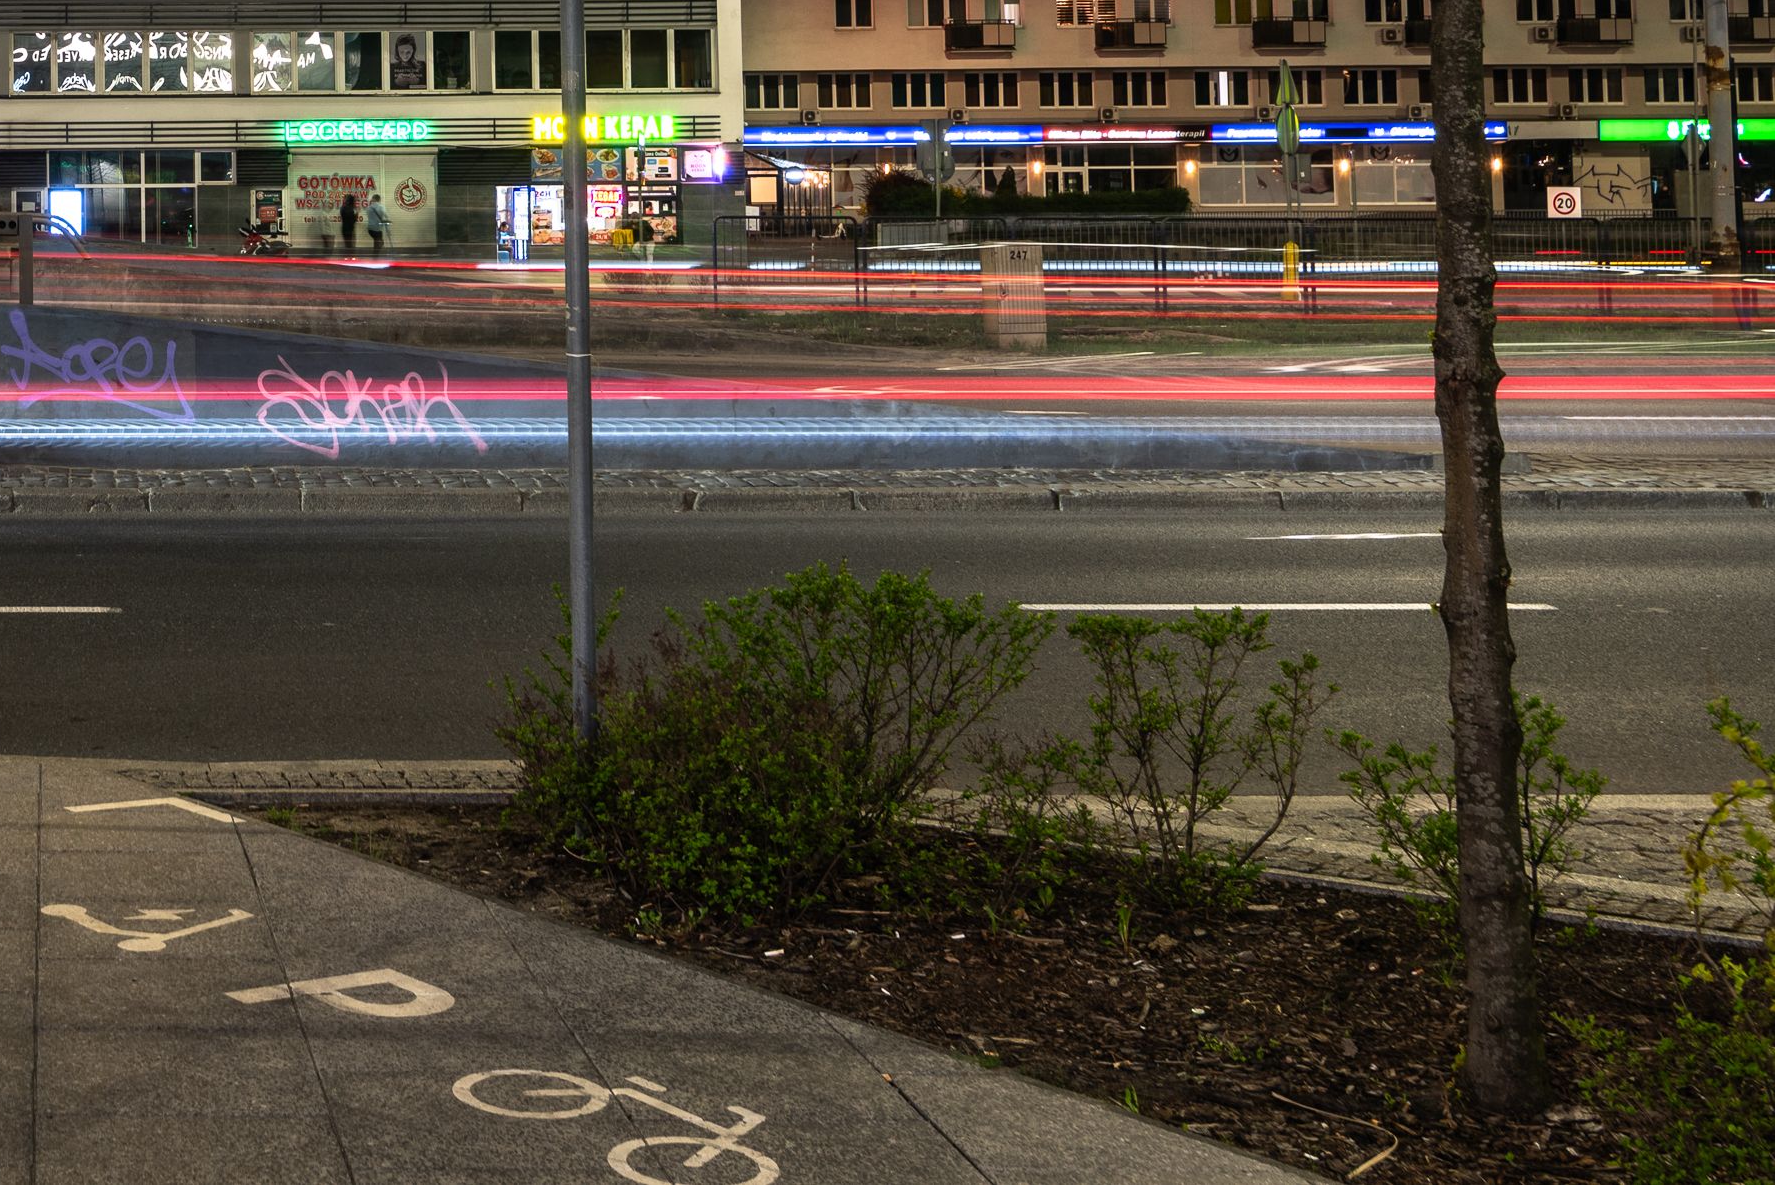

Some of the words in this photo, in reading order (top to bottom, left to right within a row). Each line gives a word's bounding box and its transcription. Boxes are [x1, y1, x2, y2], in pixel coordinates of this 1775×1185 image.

[534, 116, 598, 140] MON
[298, 173, 376, 190] GOTÓWKA
[1557, 197, 1572, 209] 20
[1010, 250, 1027, 260] 247
